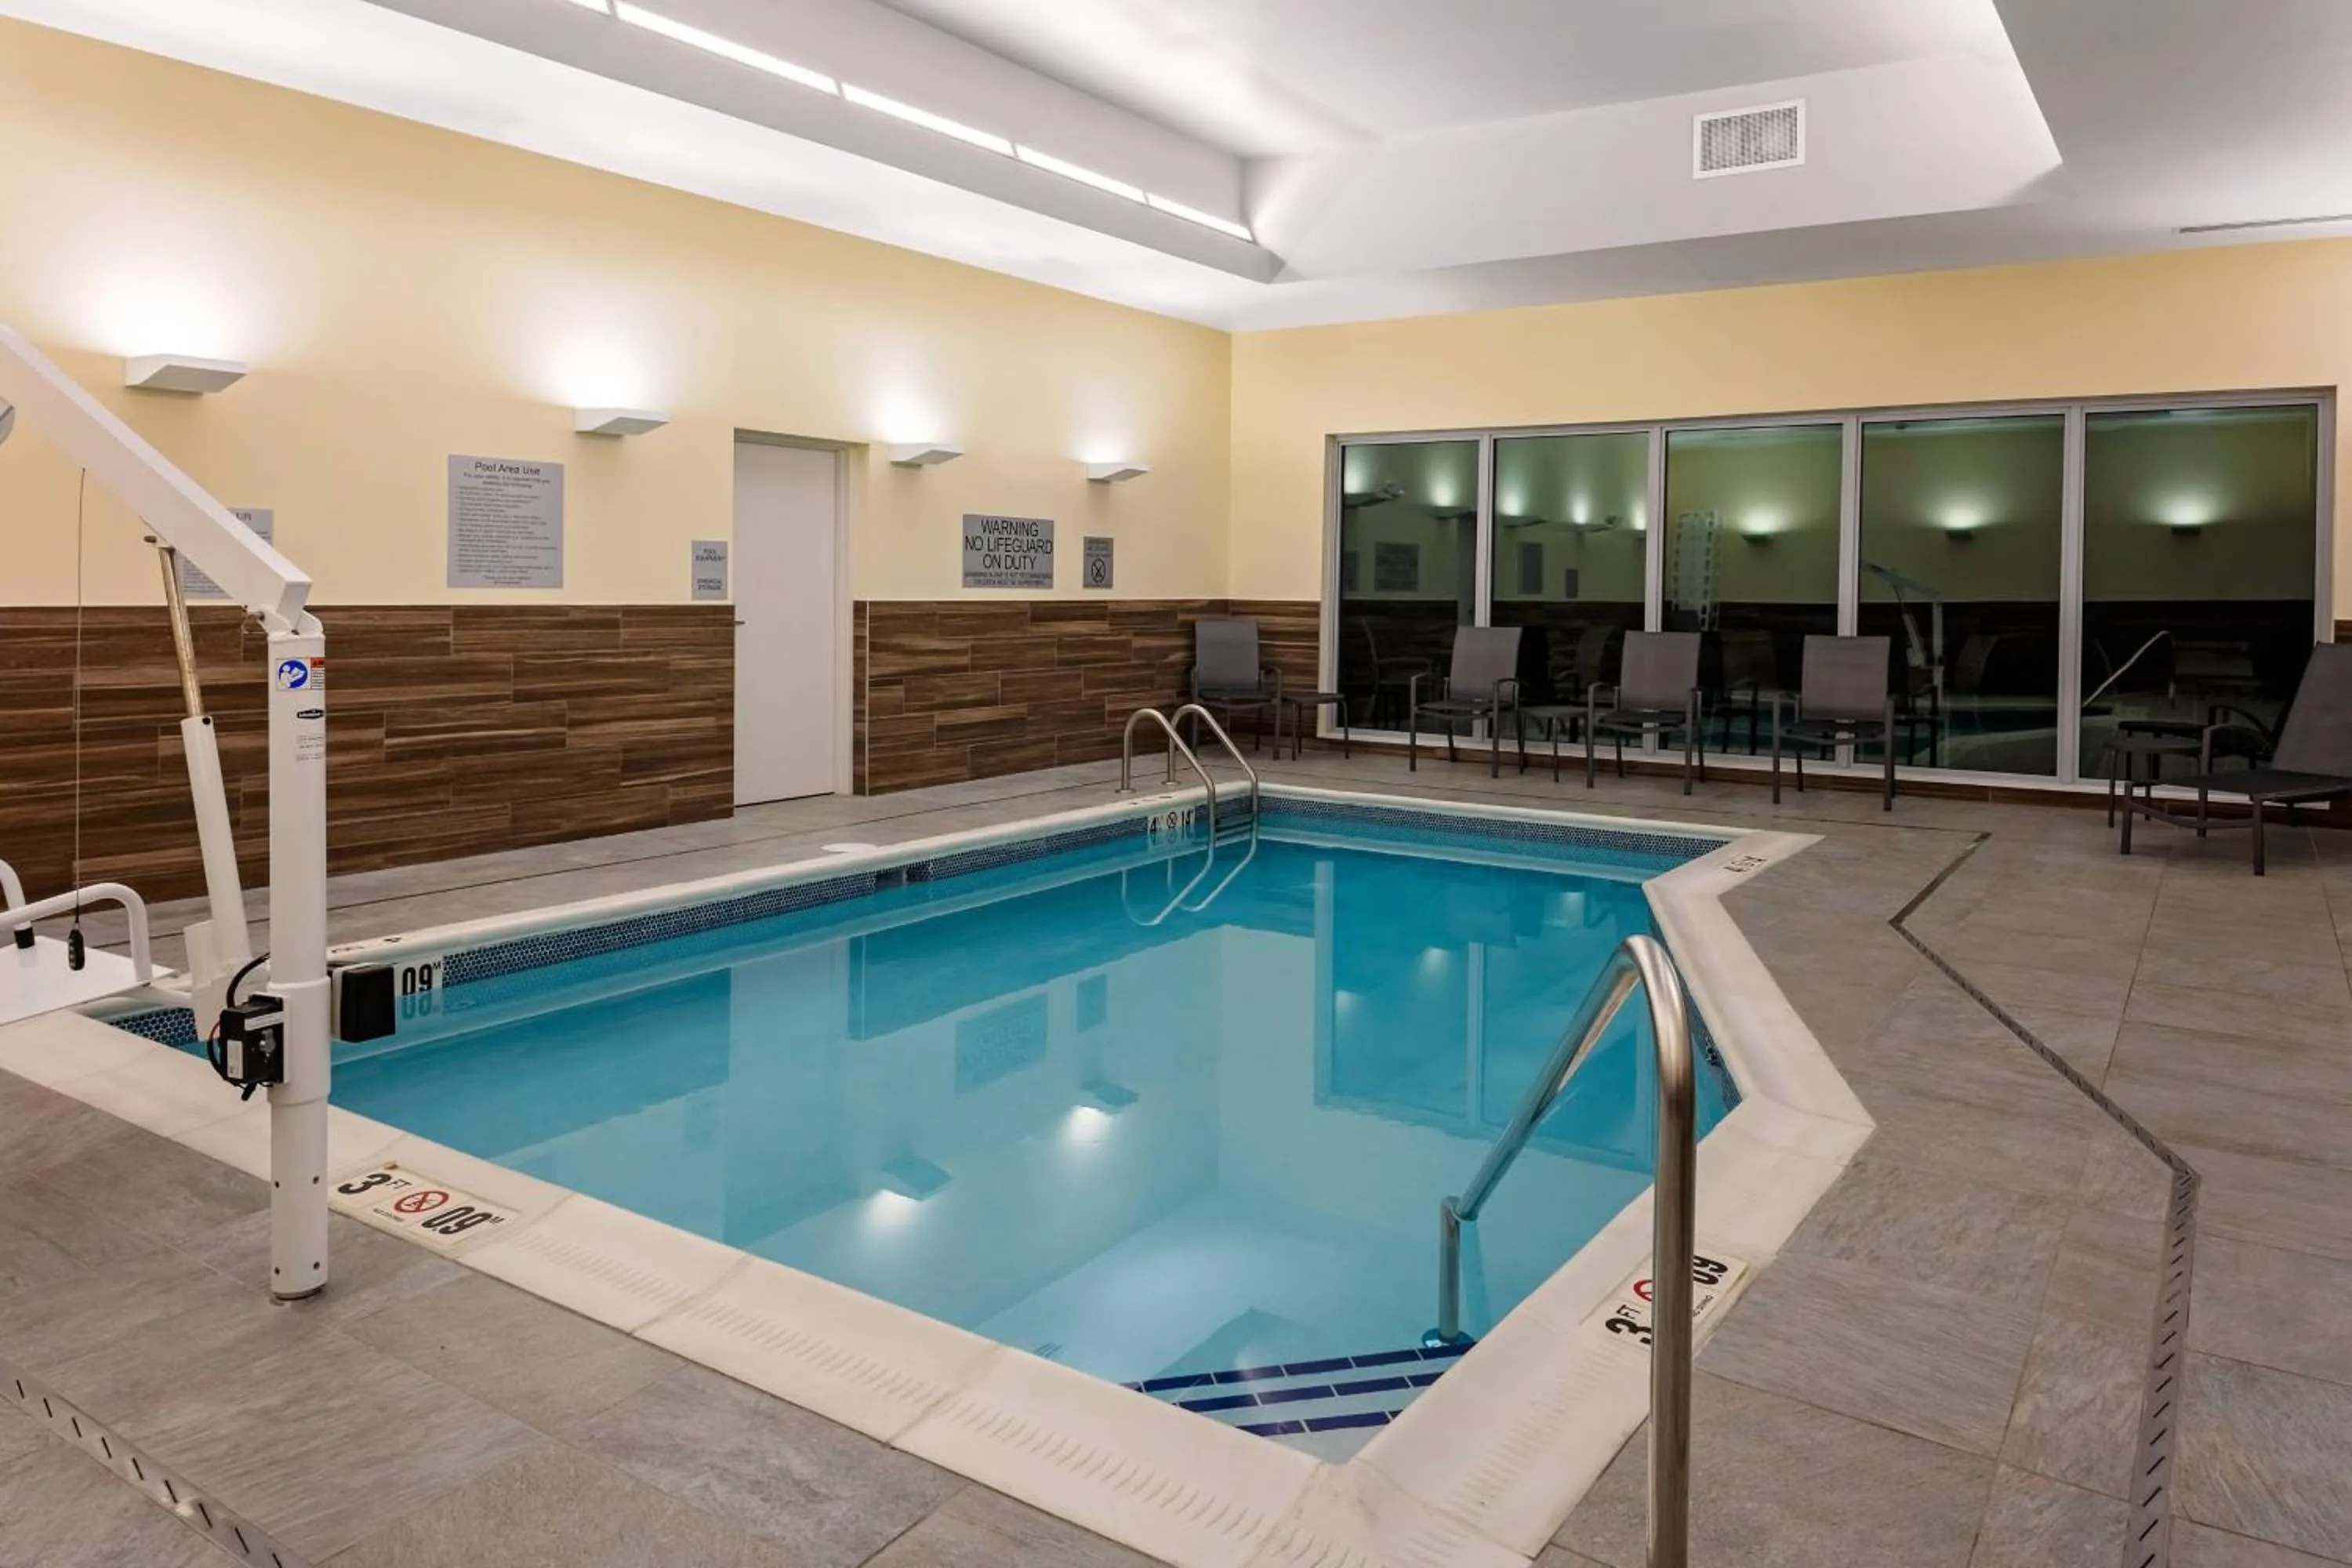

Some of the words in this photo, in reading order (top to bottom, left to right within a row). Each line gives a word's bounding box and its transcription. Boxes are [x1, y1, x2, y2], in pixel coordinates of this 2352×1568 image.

[474, 462, 496, 472] Pool
[498, 463, 520, 474] Area
[523, 466, 540, 476] Use
[981, 519, 1039, 536] WARNING
[965, 535, 983, 551] NO
[987, 536, 1053, 554] LIFEGUARD
[982, 553, 1001, 569] ON
[1005, 554, 1037, 571] DUTY
[337, 1172, 392, 1195] 3
[1615, 1304, 1641, 1319] FT
